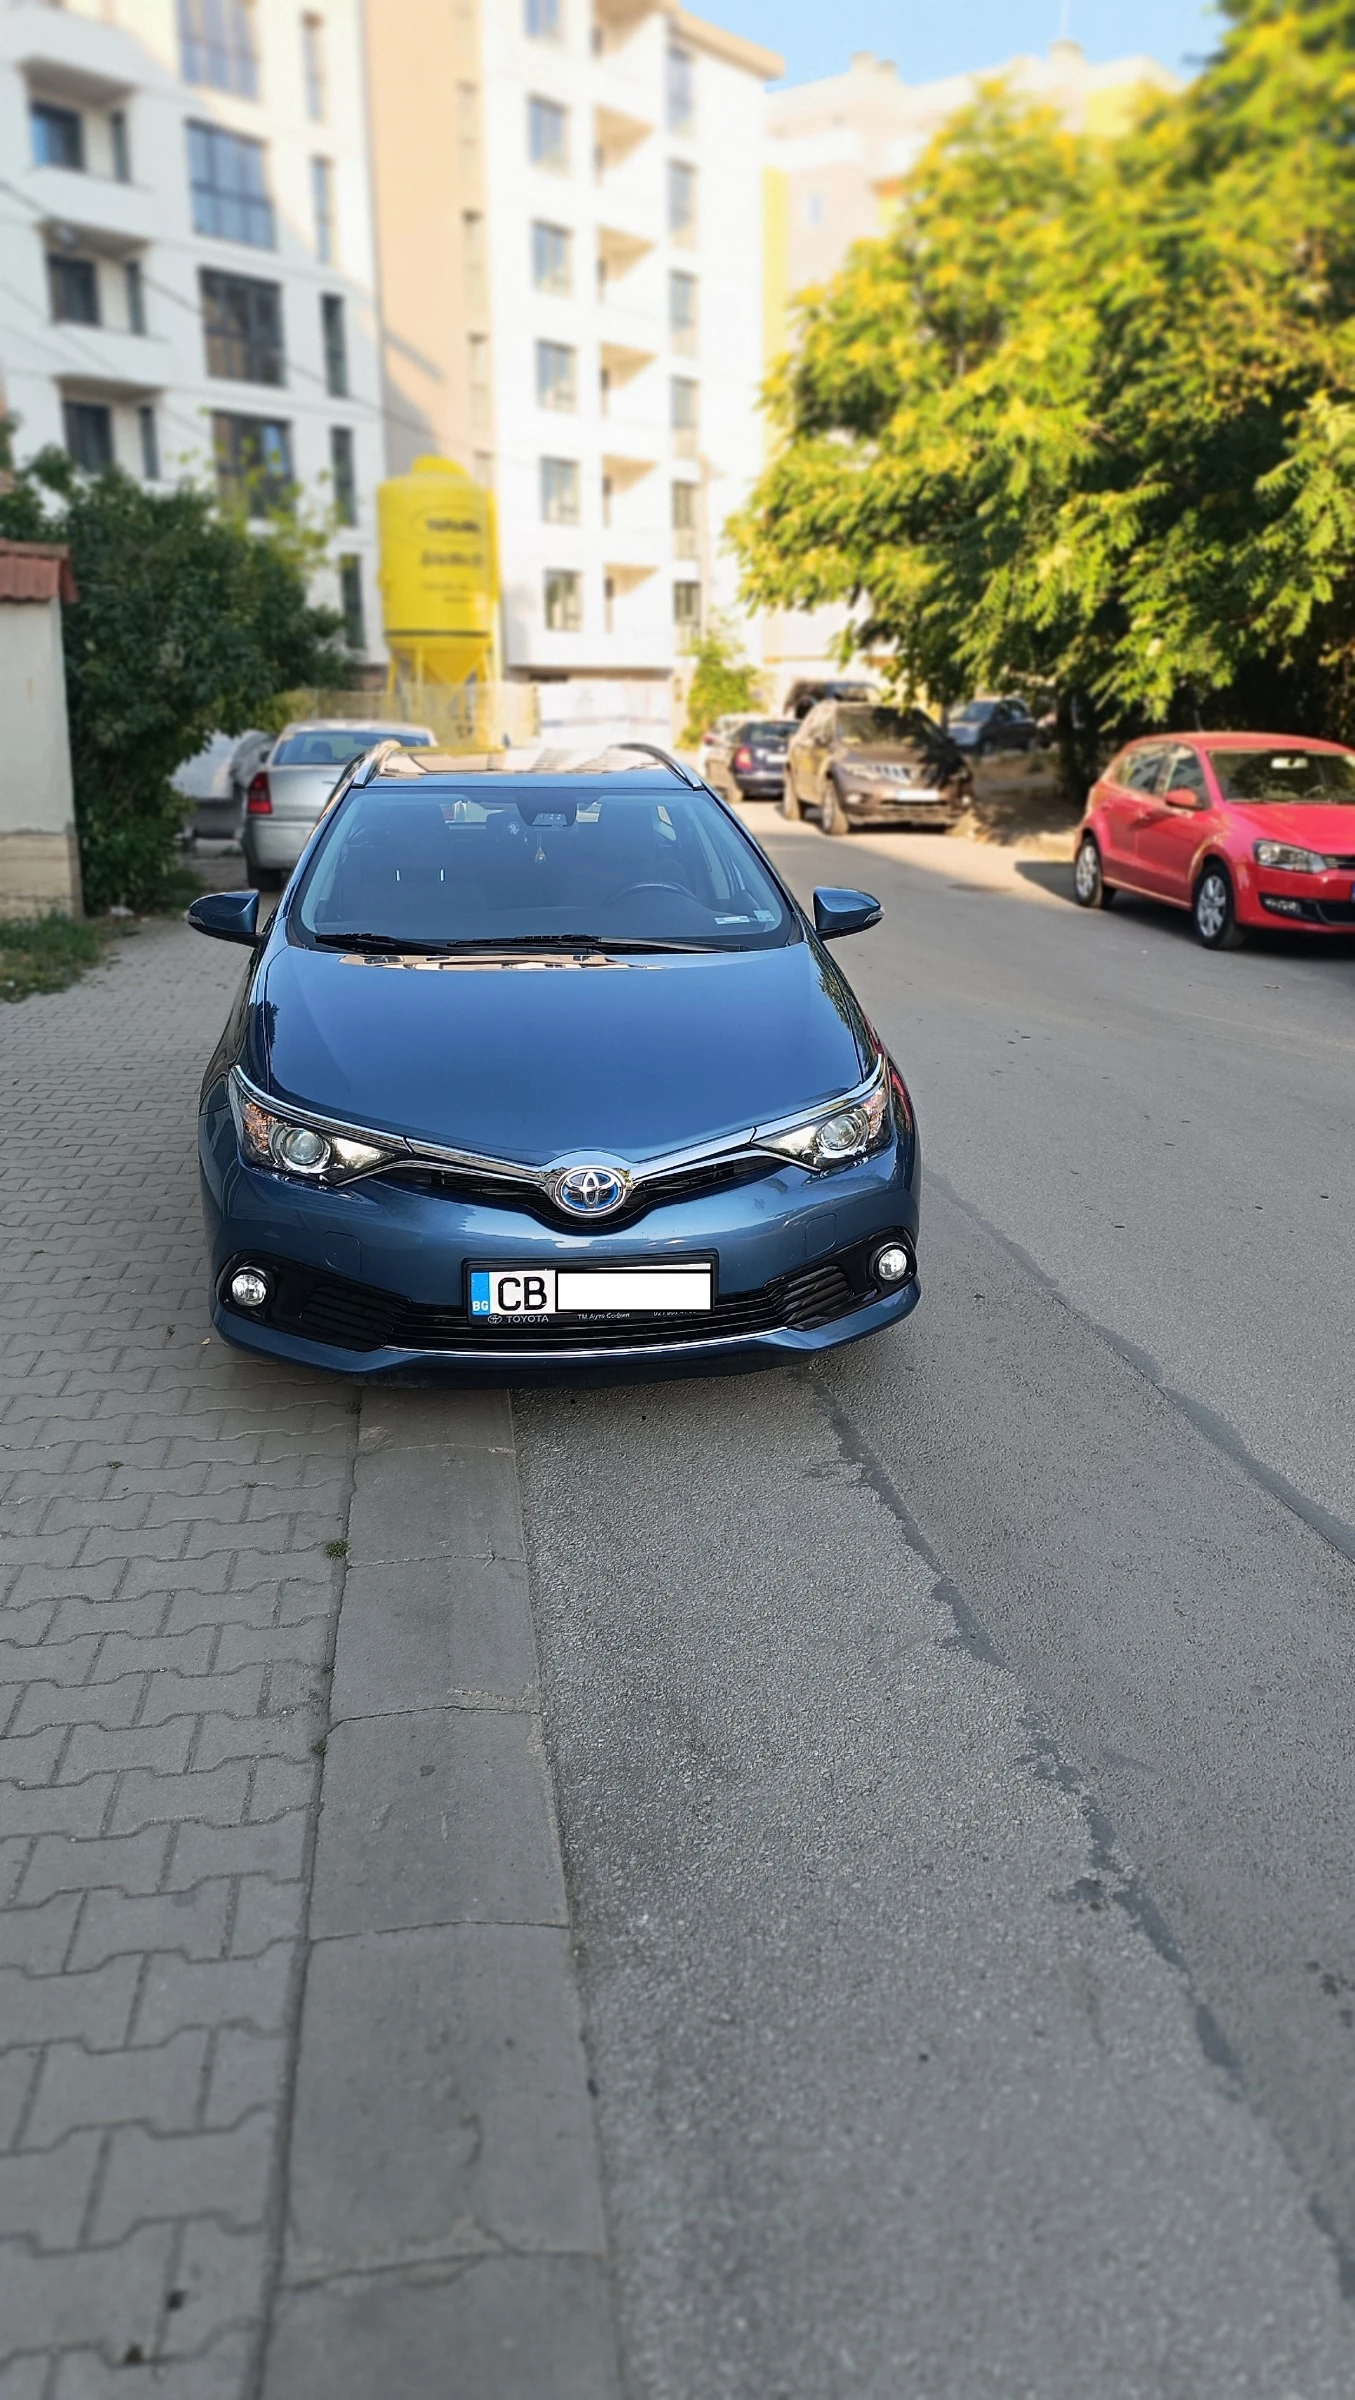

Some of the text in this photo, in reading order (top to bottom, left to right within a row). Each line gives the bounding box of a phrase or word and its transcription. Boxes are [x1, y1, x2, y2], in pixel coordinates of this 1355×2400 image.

[497, 1276, 548, 1312] CB
[472, 1300, 489, 1312] BG
[506, 1314, 549, 1324] TOYOTA
